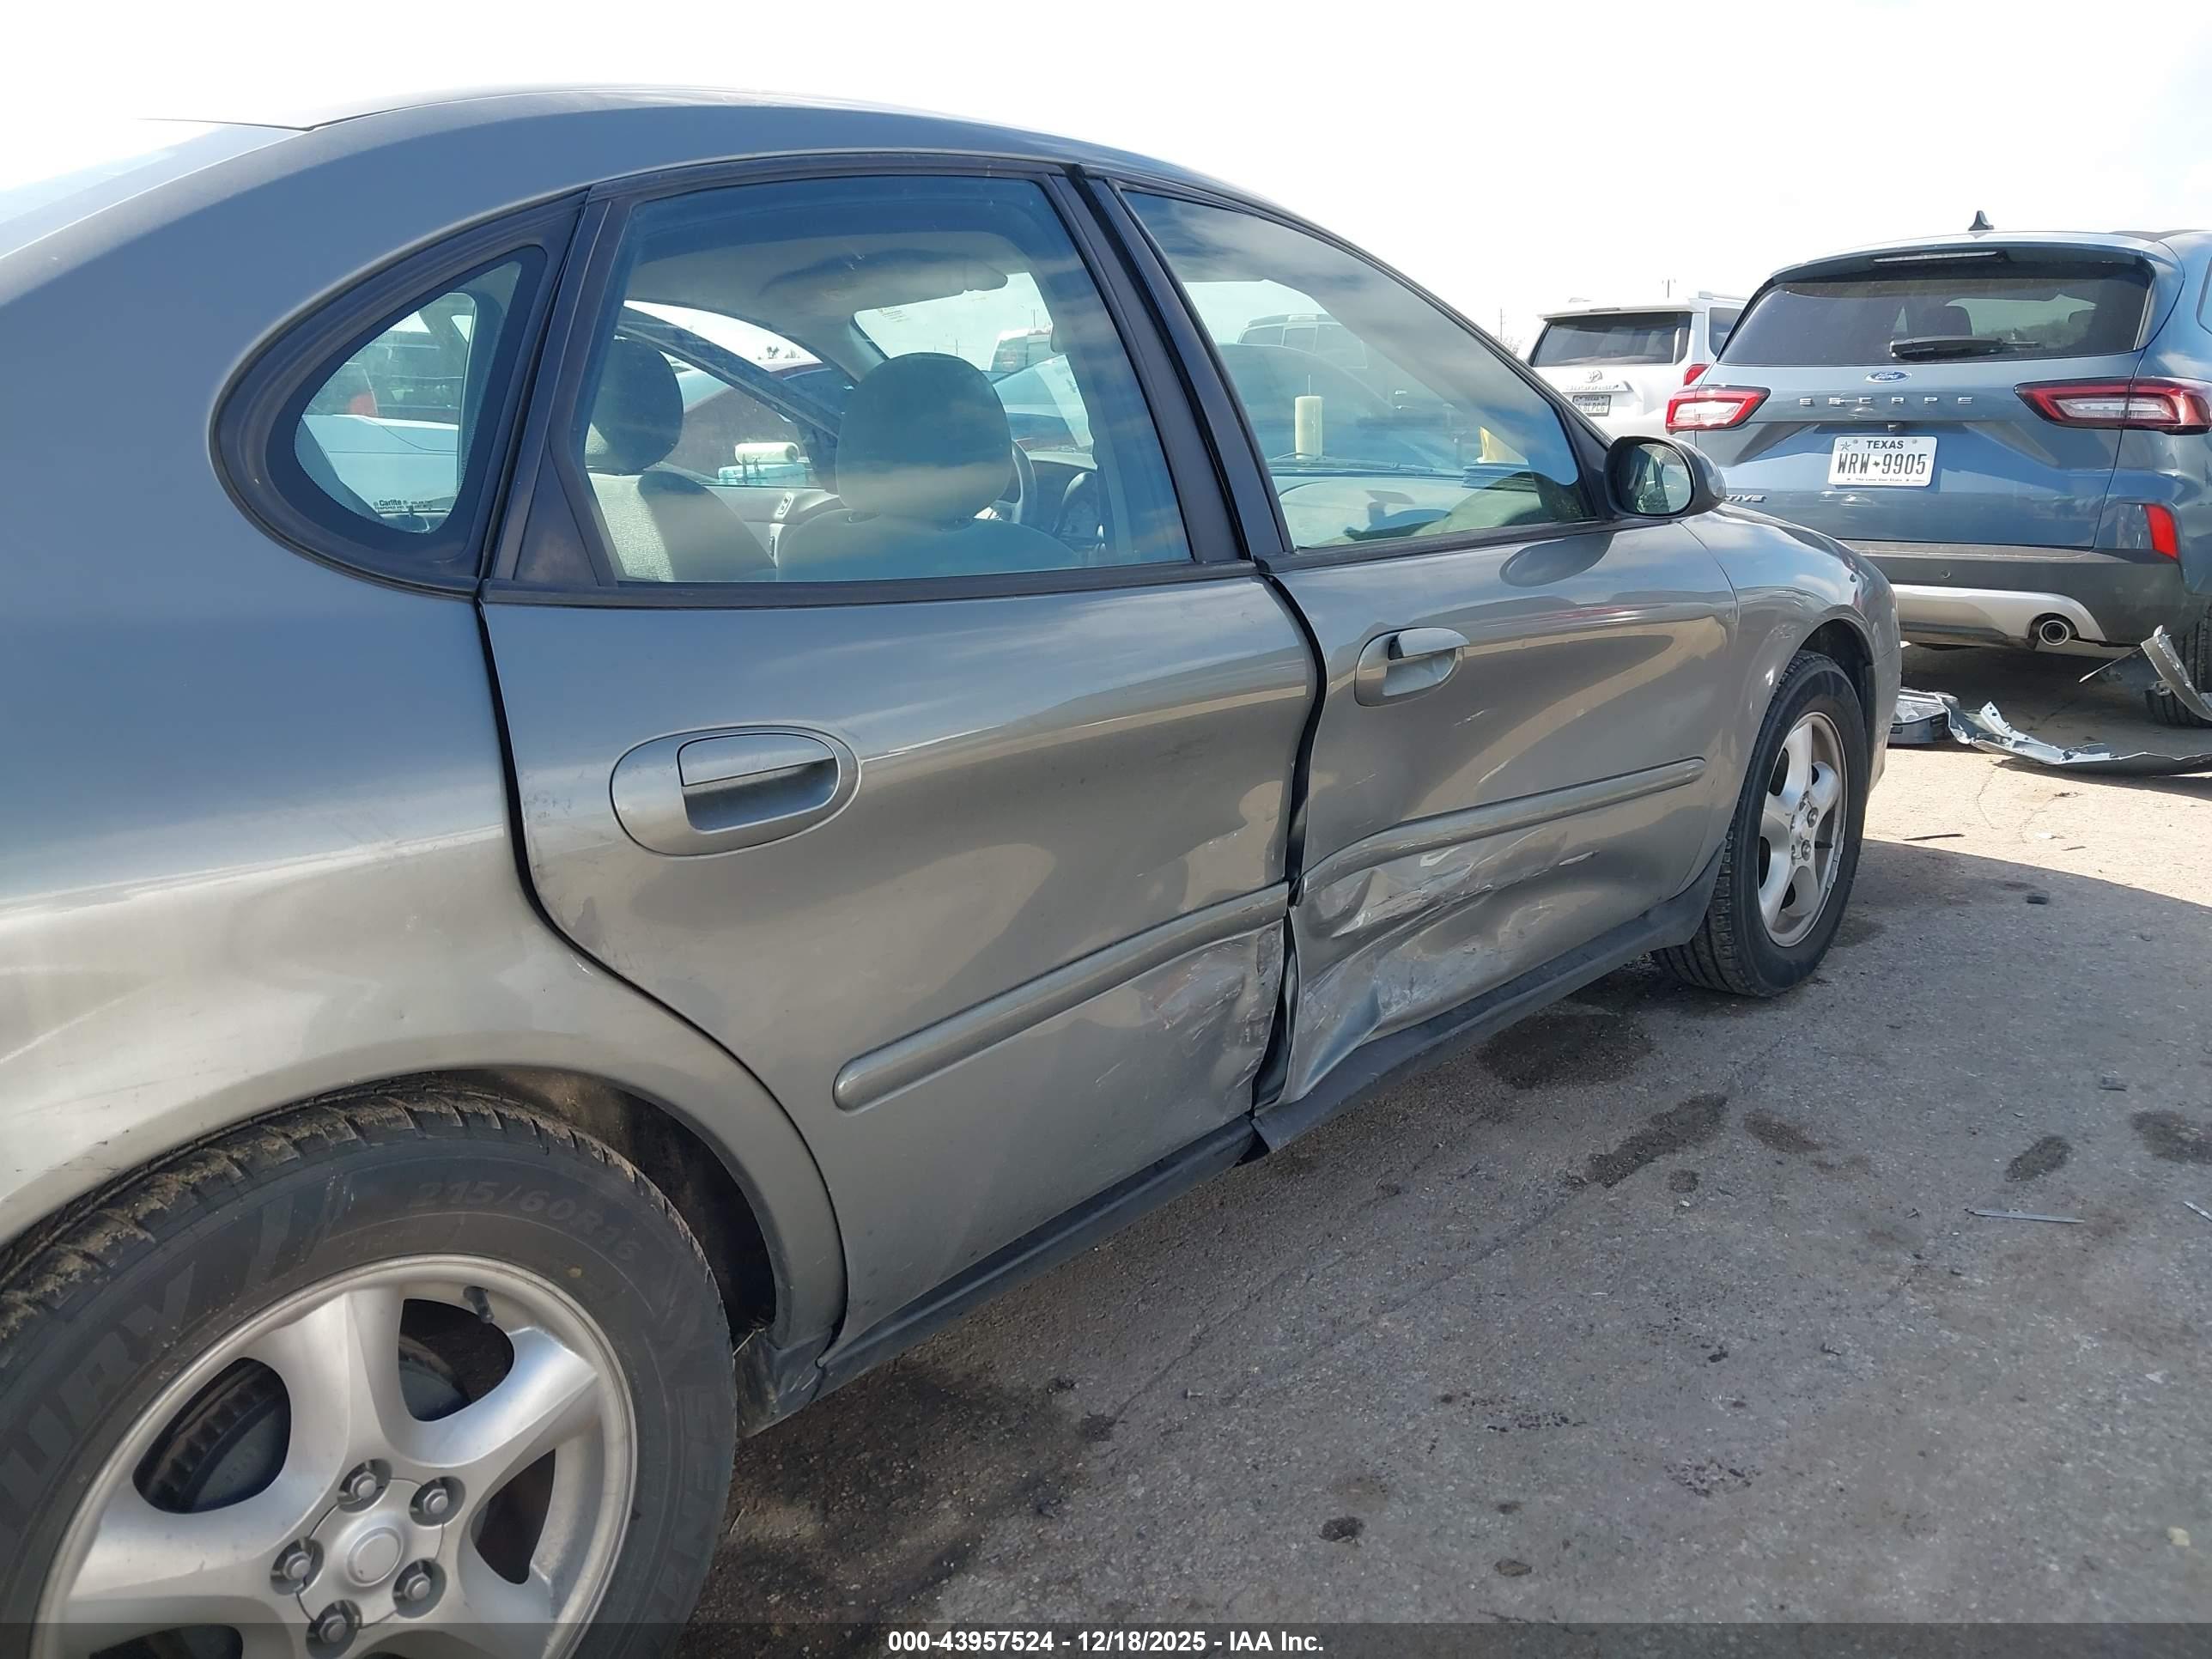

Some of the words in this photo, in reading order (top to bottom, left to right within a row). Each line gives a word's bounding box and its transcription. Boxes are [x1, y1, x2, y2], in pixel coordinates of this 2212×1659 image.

[1799, 397, 1973, 405] ESCAPE
[1866, 440, 1905, 449] TEXAS
[1725, 494, 1767, 502] TIVE
[408, 1180, 643, 1261] 215/60R16
